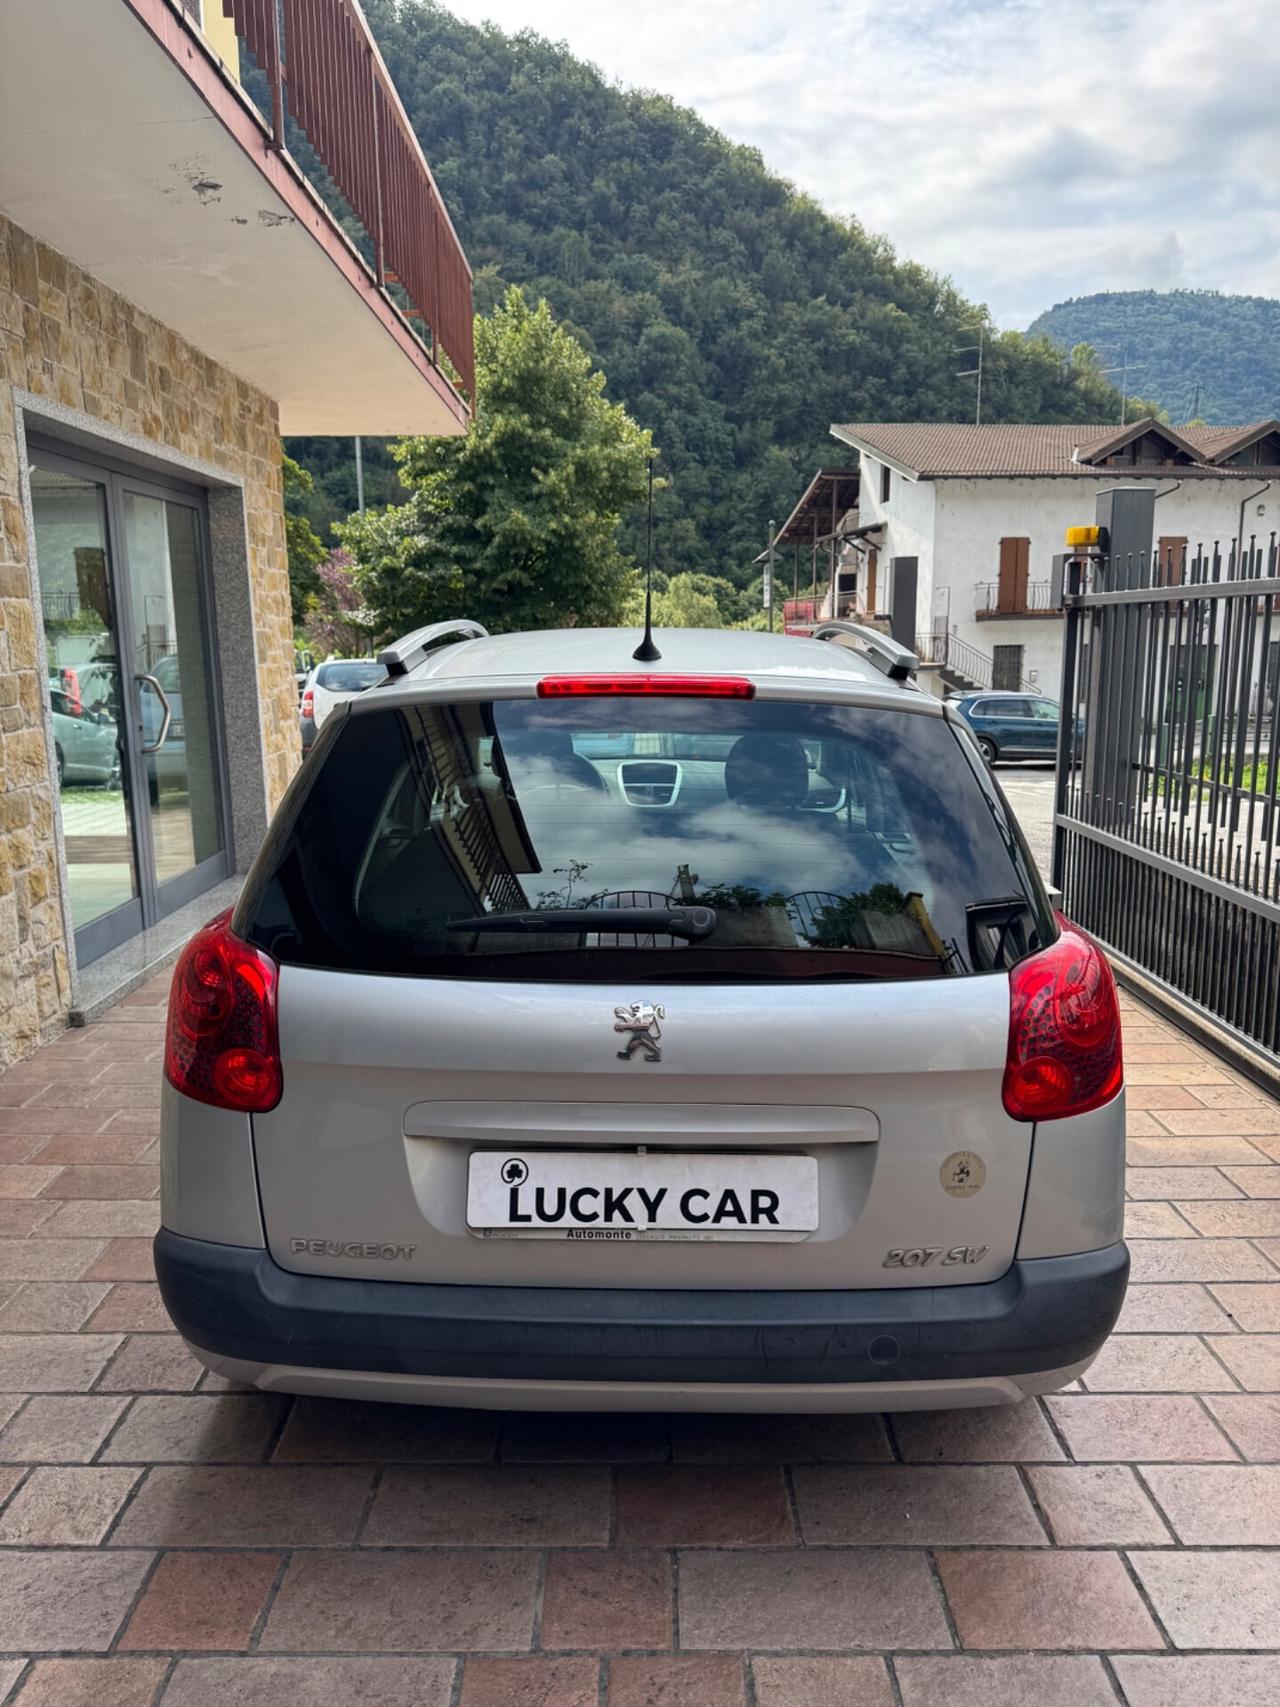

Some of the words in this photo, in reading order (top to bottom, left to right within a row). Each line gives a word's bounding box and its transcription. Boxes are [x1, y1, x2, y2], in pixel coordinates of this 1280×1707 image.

[509, 1187, 668, 1223] LUCKY
[679, 1188, 781, 1225] CAR
[566, 1229, 632, 1240] Automonte
[290, 1238, 417, 1260] PEUGEOT
[882, 1247, 942, 1268] 207
[942, 1244, 991, 1266] SW
